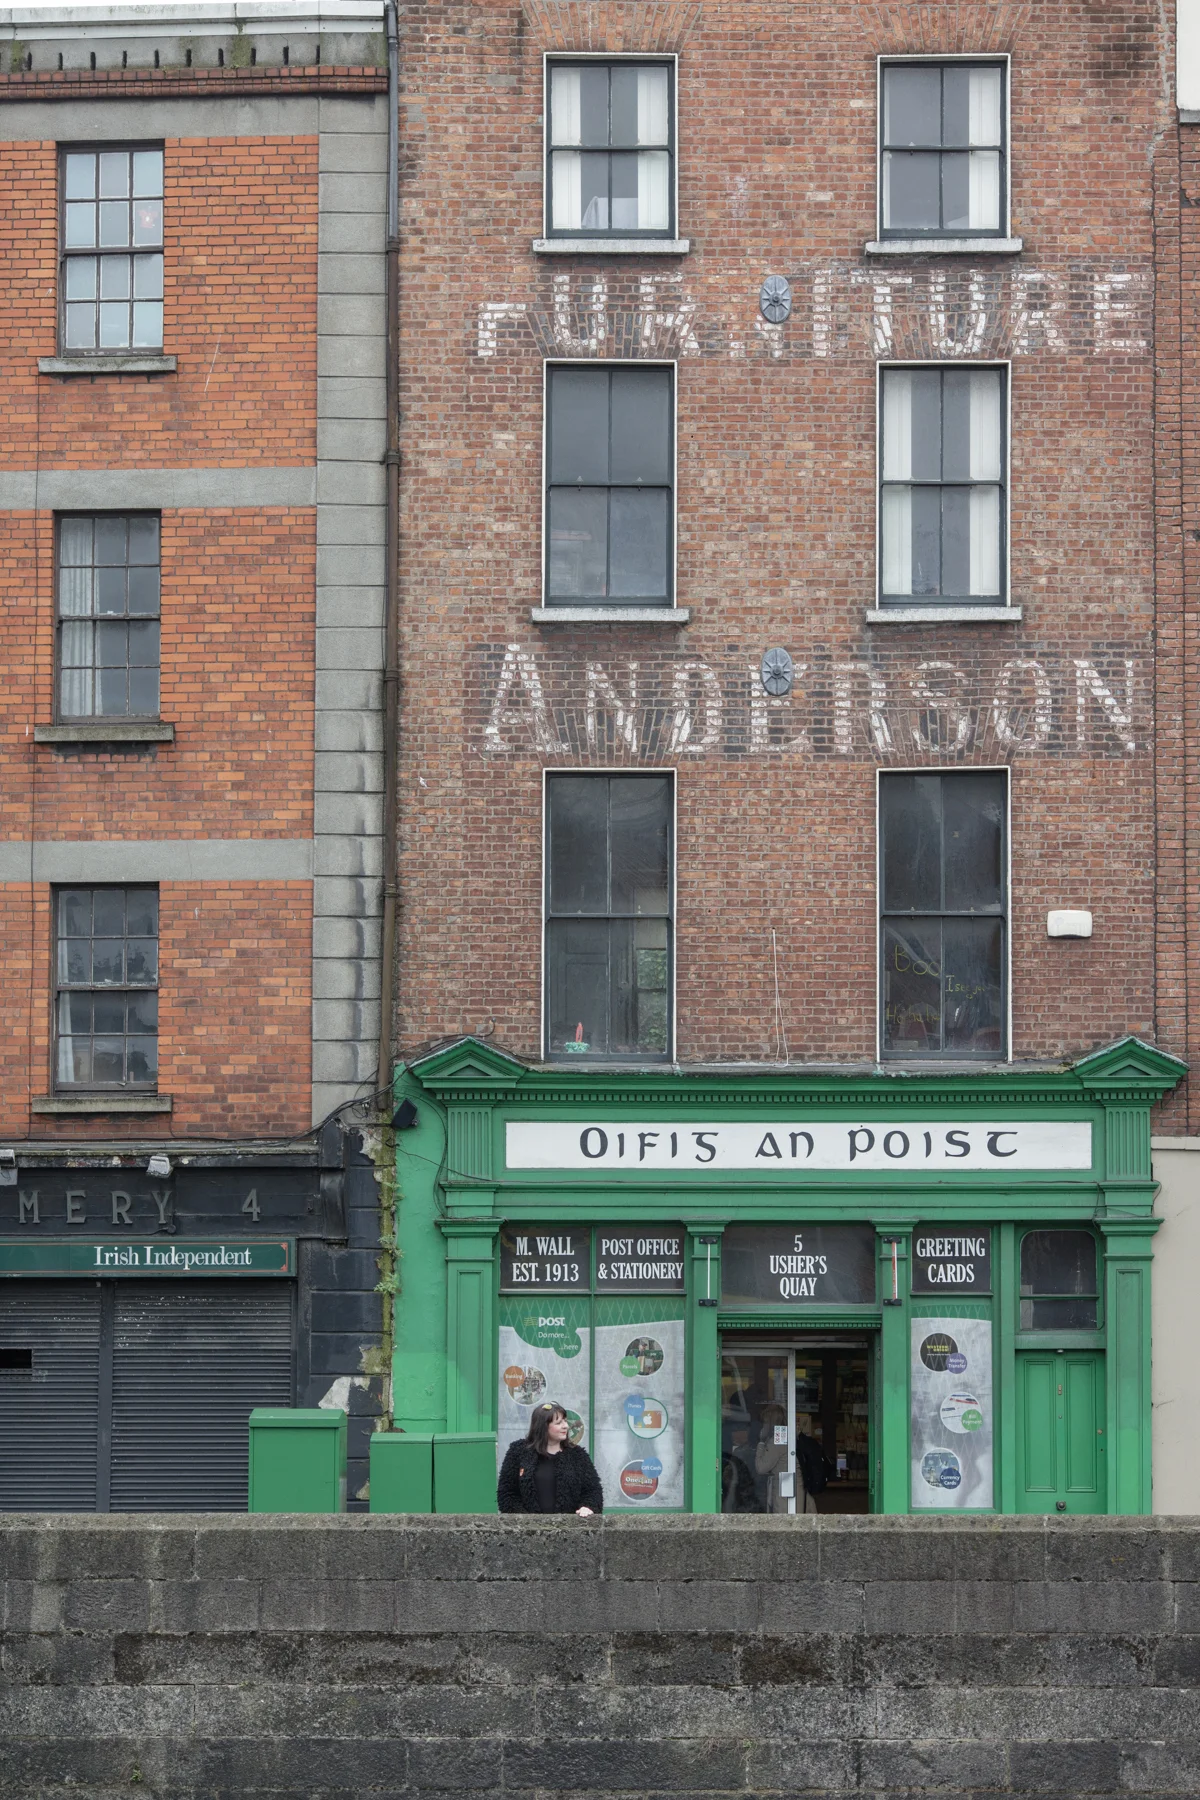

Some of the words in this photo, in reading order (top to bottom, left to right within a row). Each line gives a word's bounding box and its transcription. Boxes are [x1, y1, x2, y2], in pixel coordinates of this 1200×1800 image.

[474, 643, 1138, 753] ANDERSON
[894, 944, 941, 977] Boo
[18, 1189, 173, 1225] MERY
[241, 1188, 261, 1222] 4
[516, 1236, 532, 1256] M.
[536, 1236, 575, 1256] WALL
[601, 1238, 633, 1256] POST
[636, 1238, 680, 1256] OFFICE
[794, 1234, 803, 1253] 5
[916, 1237, 986, 1257] GREETING
[93, 1246, 139, 1266] Irish
[143, 1246, 252, 1270] Independent
[512, 1262, 540, 1282] EST.
[545, 1263, 579, 1282] 1913
[597, 1262, 608, 1280] &
[611, 1262, 684, 1280] STATIONERY
[927, 1264, 975, 1283] CARDS
[779, 1277, 817, 1299] QUAY
[538, 1316, 566, 1327] post
